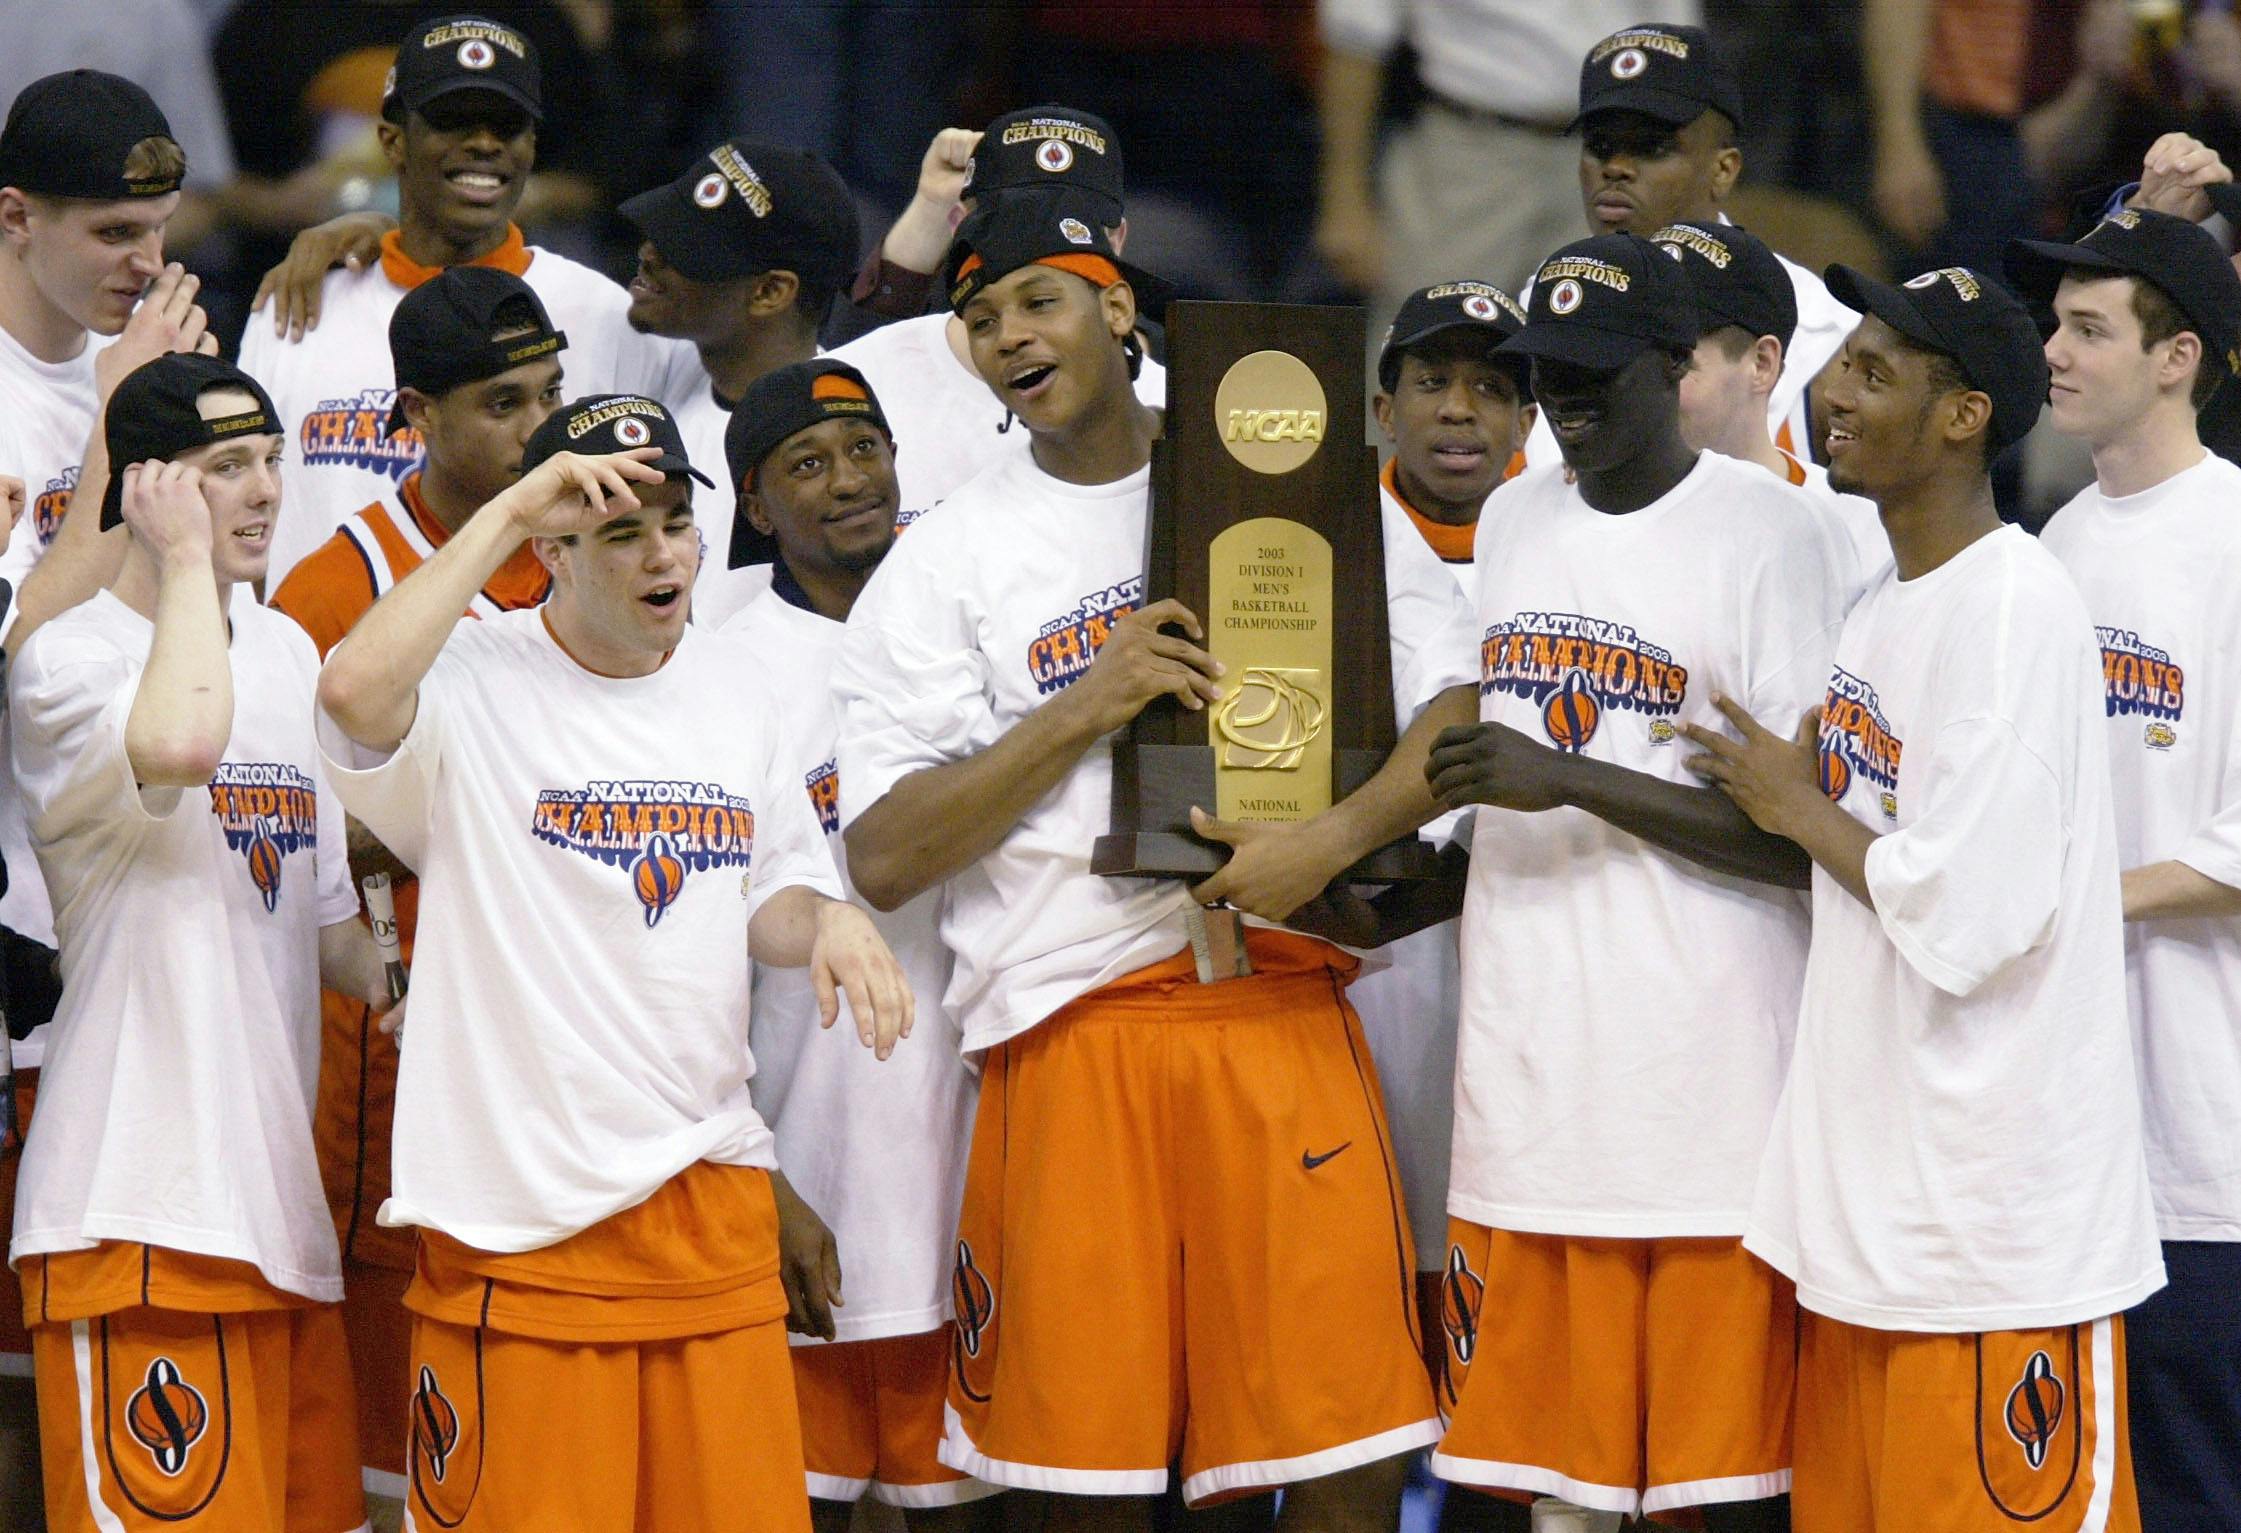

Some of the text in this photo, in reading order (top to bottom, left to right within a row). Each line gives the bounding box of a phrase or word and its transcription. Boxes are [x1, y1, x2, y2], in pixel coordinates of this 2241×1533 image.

[423, 26, 525, 58] CHAMPIONS
[1031, 119, 1085, 130] NATIONAL
[1002, 126, 1106, 155] CHAMPIONS
[1227, 409, 1321, 442] NCAA
[1257, 547, 1285, 559] 2003
[1239, 564, 1294, 577] DIVISION
[1252, 582, 1289, 595] MEN'S
[1232, 600, 1309, 613] BASKETBALL
[1041, 609, 1082, 637] NCAA
[1224, 616, 1317, 631] CHAMPIONSHIP
[1639, 643, 1670, 662] 2003
[1481, 634, 1687, 703] HAMPIONS
[215, 764, 301, 786] NATIONAL
[540, 791, 583, 802] NCAA
[587, 782, 728, 804] NATIONAL
[210, 785, 317, 834] AMPION
[1239, 799, 1301, 812] NATIONAL
[534, 802, 754, 853] HAMPION
